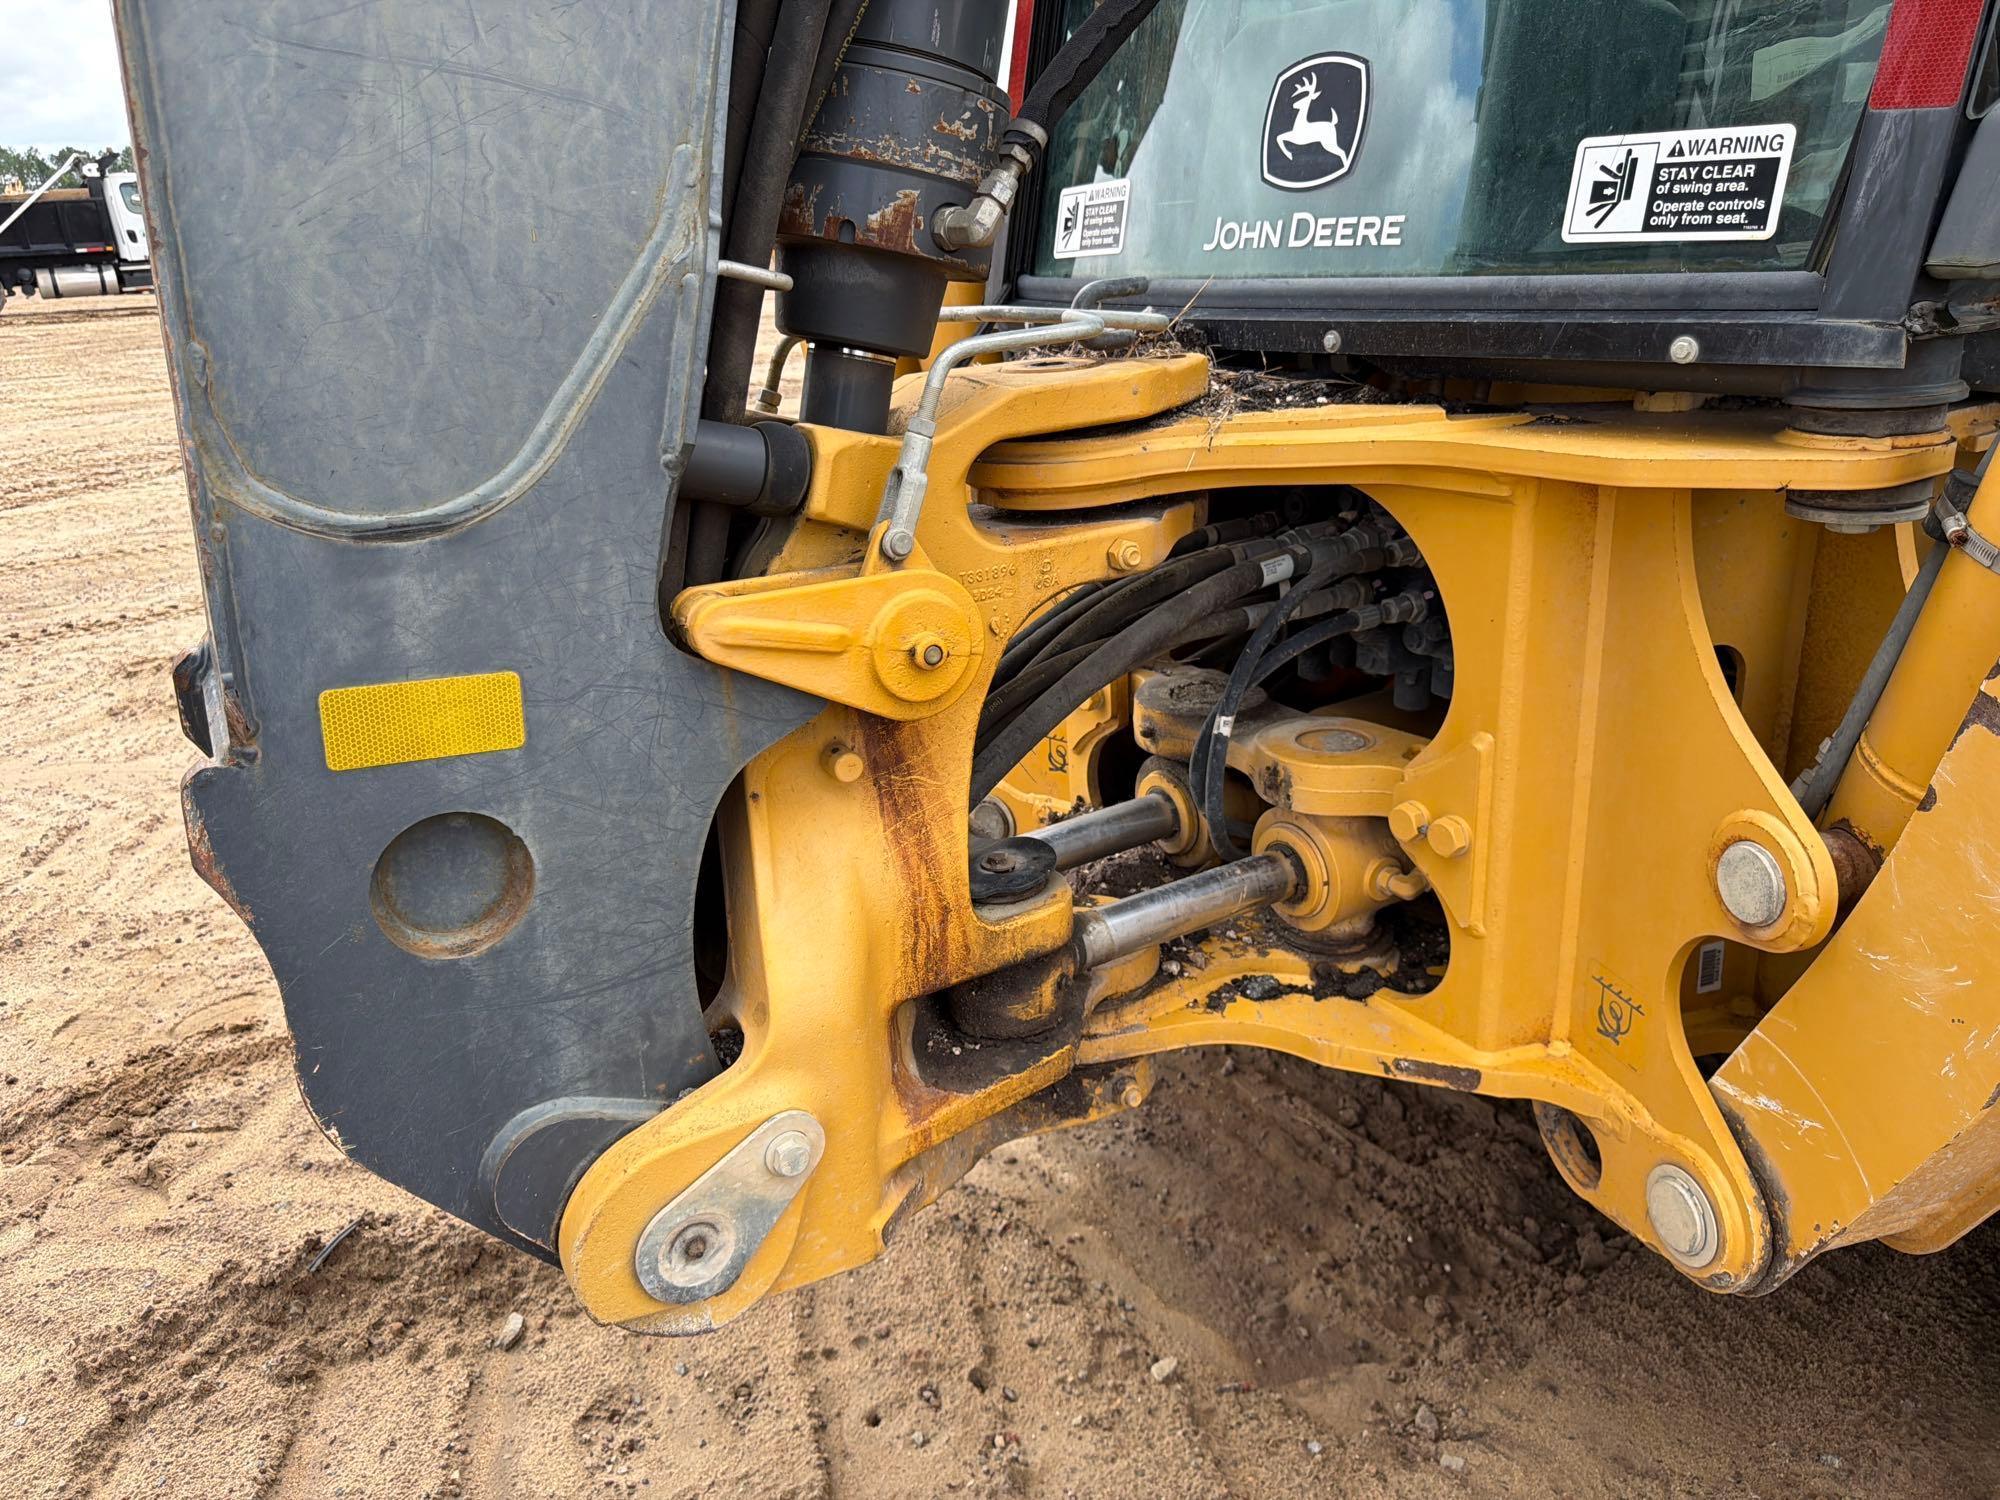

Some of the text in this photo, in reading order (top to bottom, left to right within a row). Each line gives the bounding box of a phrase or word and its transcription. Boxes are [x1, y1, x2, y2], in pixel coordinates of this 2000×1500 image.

[1688, 134, 1784, 156] WARNING
[1658, 164, 1755, 181] STAY CLEAR
[1095, 185, 1126, 200] WARNING
[1656, 181, 1749, 195] of swing area.
[1085, 204, 1117, 217] STAY CLEAR
[1652, 198, 1765, 214] Operate controls
[1650, 212, 1749, 228] only from seat.
[1083, 226, 1120, 238] Operate controls
[1203, 212, 1406, 251] JOHN DEERE
[1082, 239, 1091, 248] only
[1092, 237, 1102, 245] from
